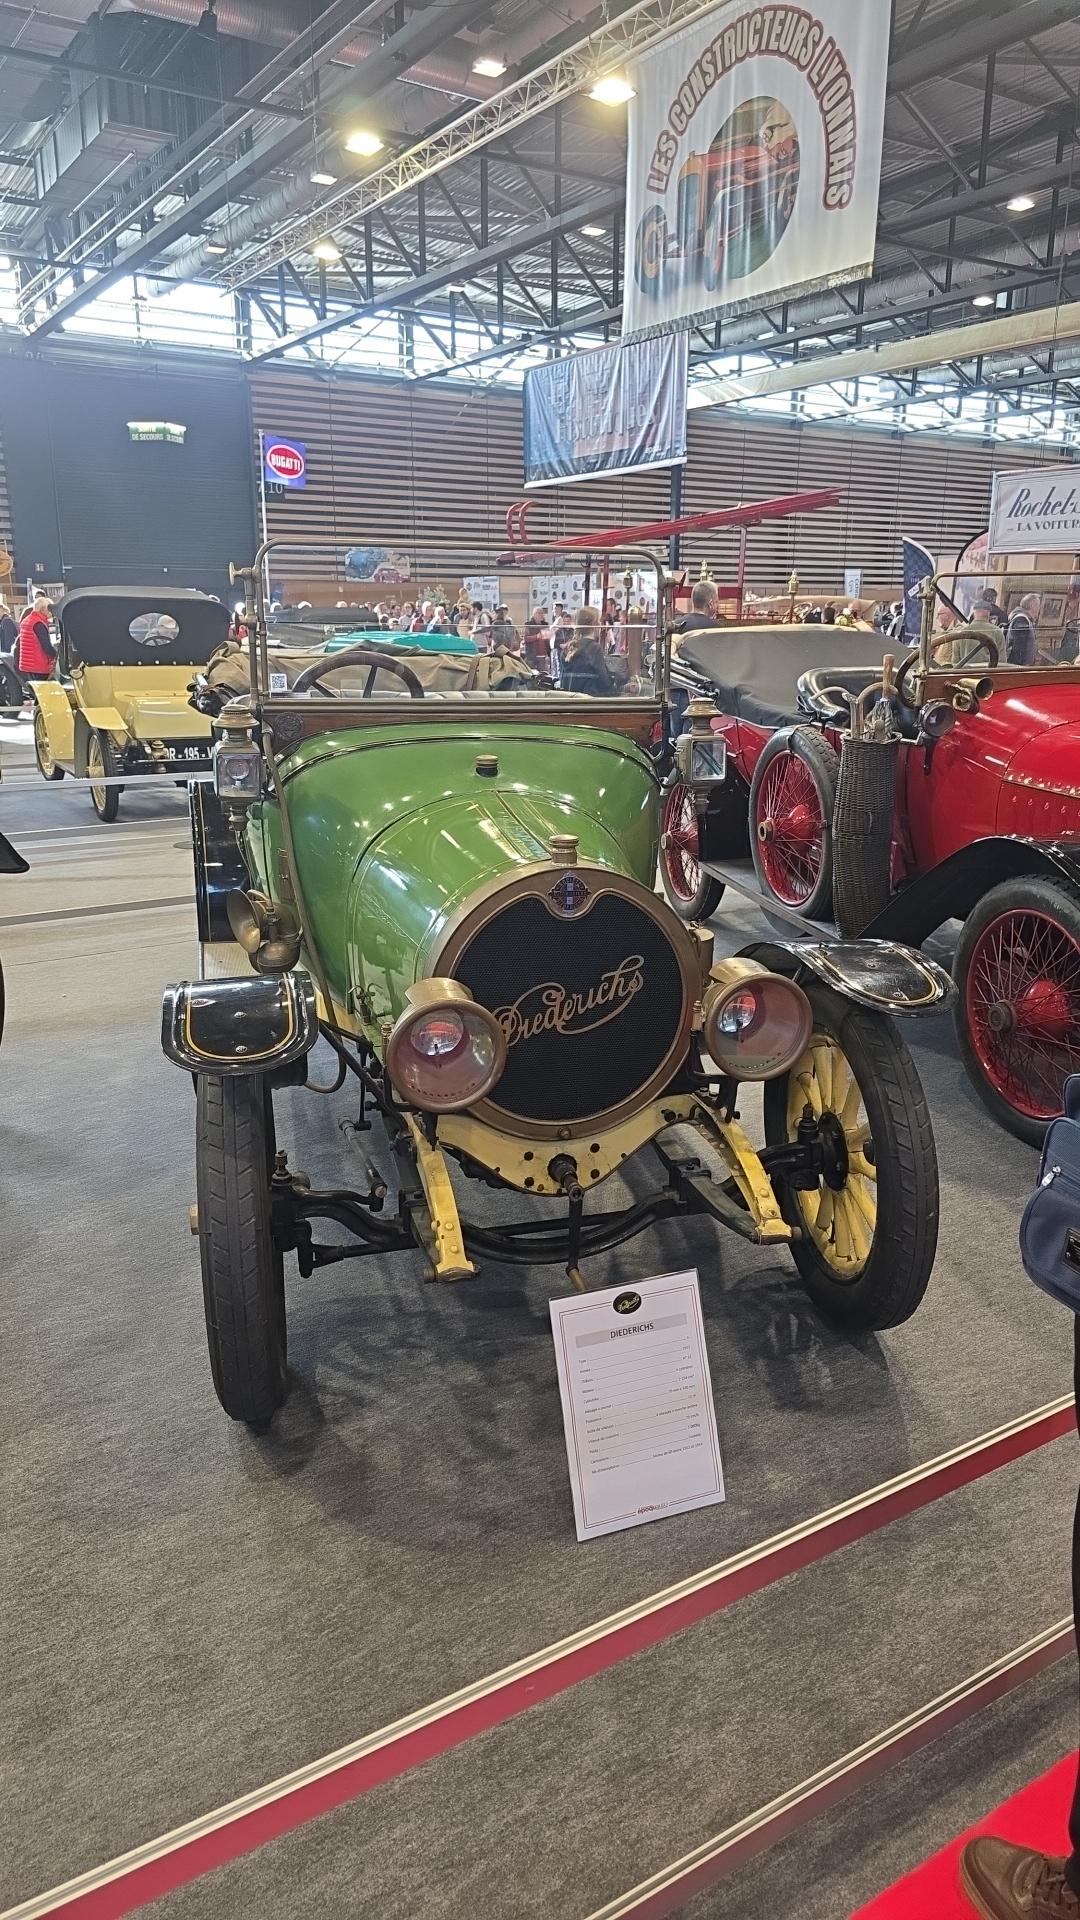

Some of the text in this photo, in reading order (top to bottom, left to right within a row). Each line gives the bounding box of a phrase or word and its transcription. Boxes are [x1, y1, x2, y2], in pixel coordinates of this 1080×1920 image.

[647, 4, 858, 211] LES CONSTRUCTEURS LYONNAIS
[271, 453, 301, 472] BUGATTI
[1016, 519, 1080, 532] LA VOITUR
[610, 1322, 654, 1339] DIEDERICHS
